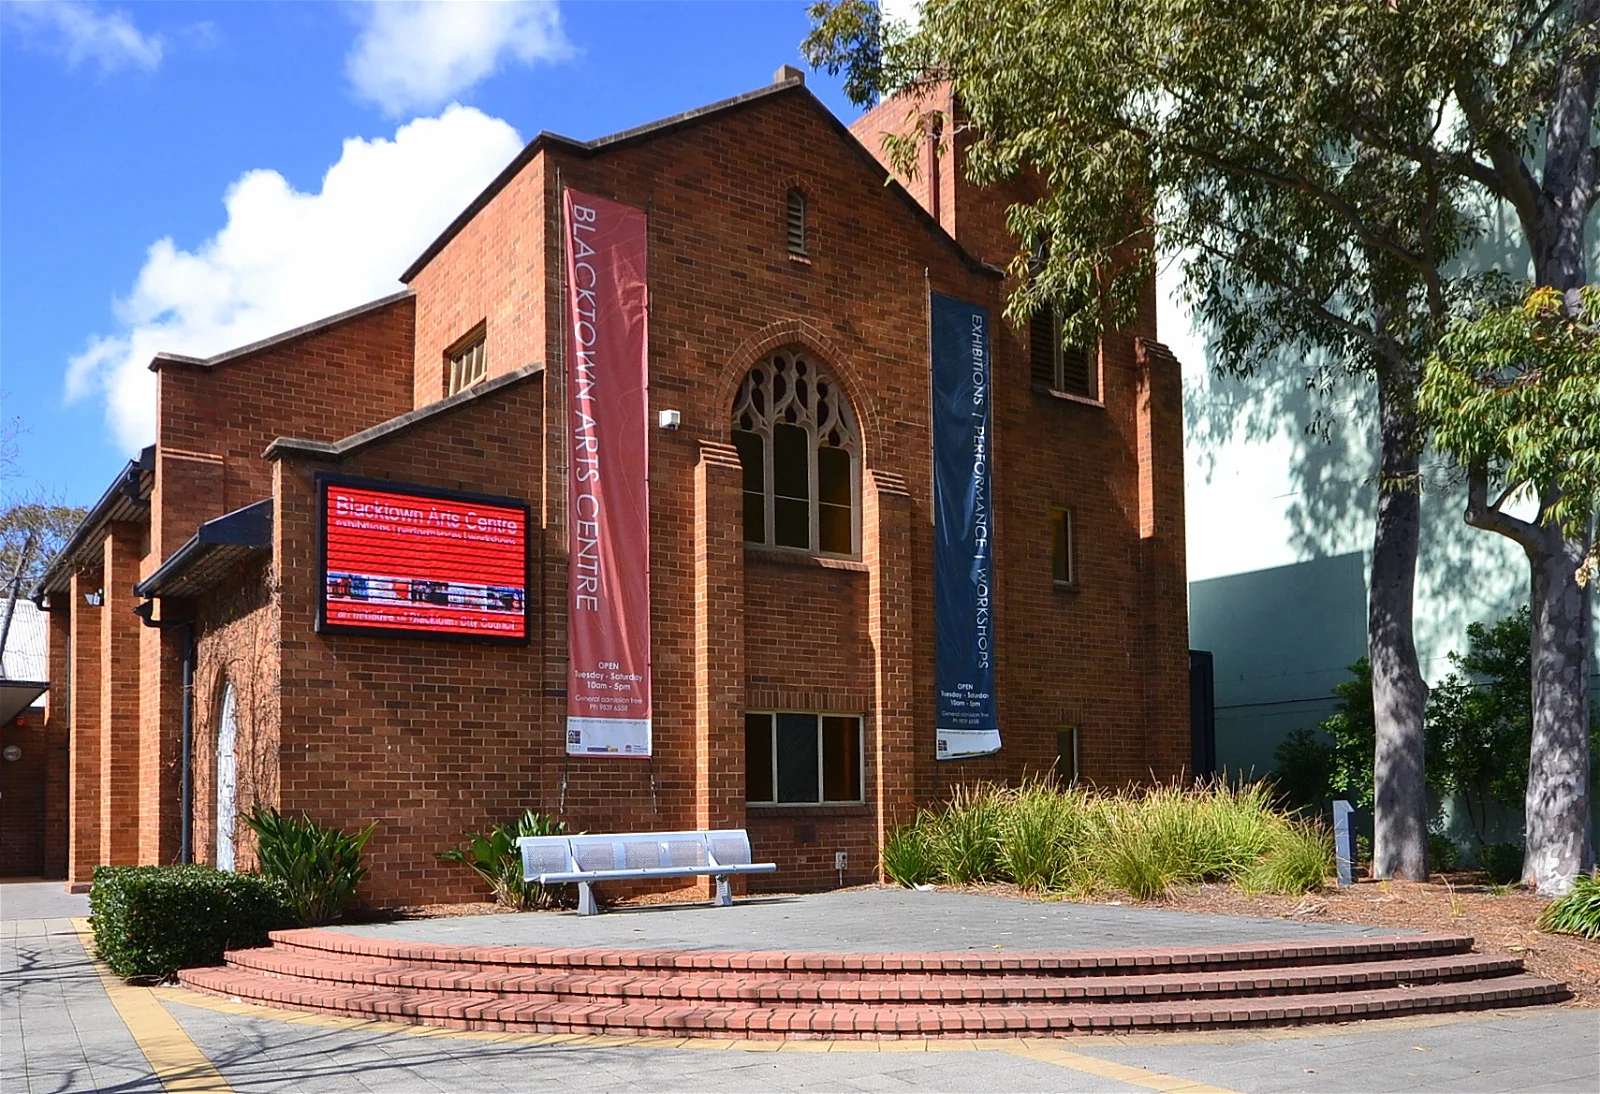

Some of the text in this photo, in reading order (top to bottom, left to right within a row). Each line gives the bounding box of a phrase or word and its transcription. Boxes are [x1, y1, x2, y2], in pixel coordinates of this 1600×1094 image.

[972, 314, 984, 406] EXHIBITIONS
[574, 204, 601, 612] BLACKTOWN ARTS CENTRE
[336, 495, 517, 535] Blacktown Arts Centre
[973, 425, 988, 548] PERFORMANCE
[976, 568, 989, 670] WORKSHOPS
[575, 670, 604, 680] Tuesday
[610, 672, 643, 682] Saturday
[587, 681, 607, 689] 10am
[614, 683, 630, 691] 5pm
